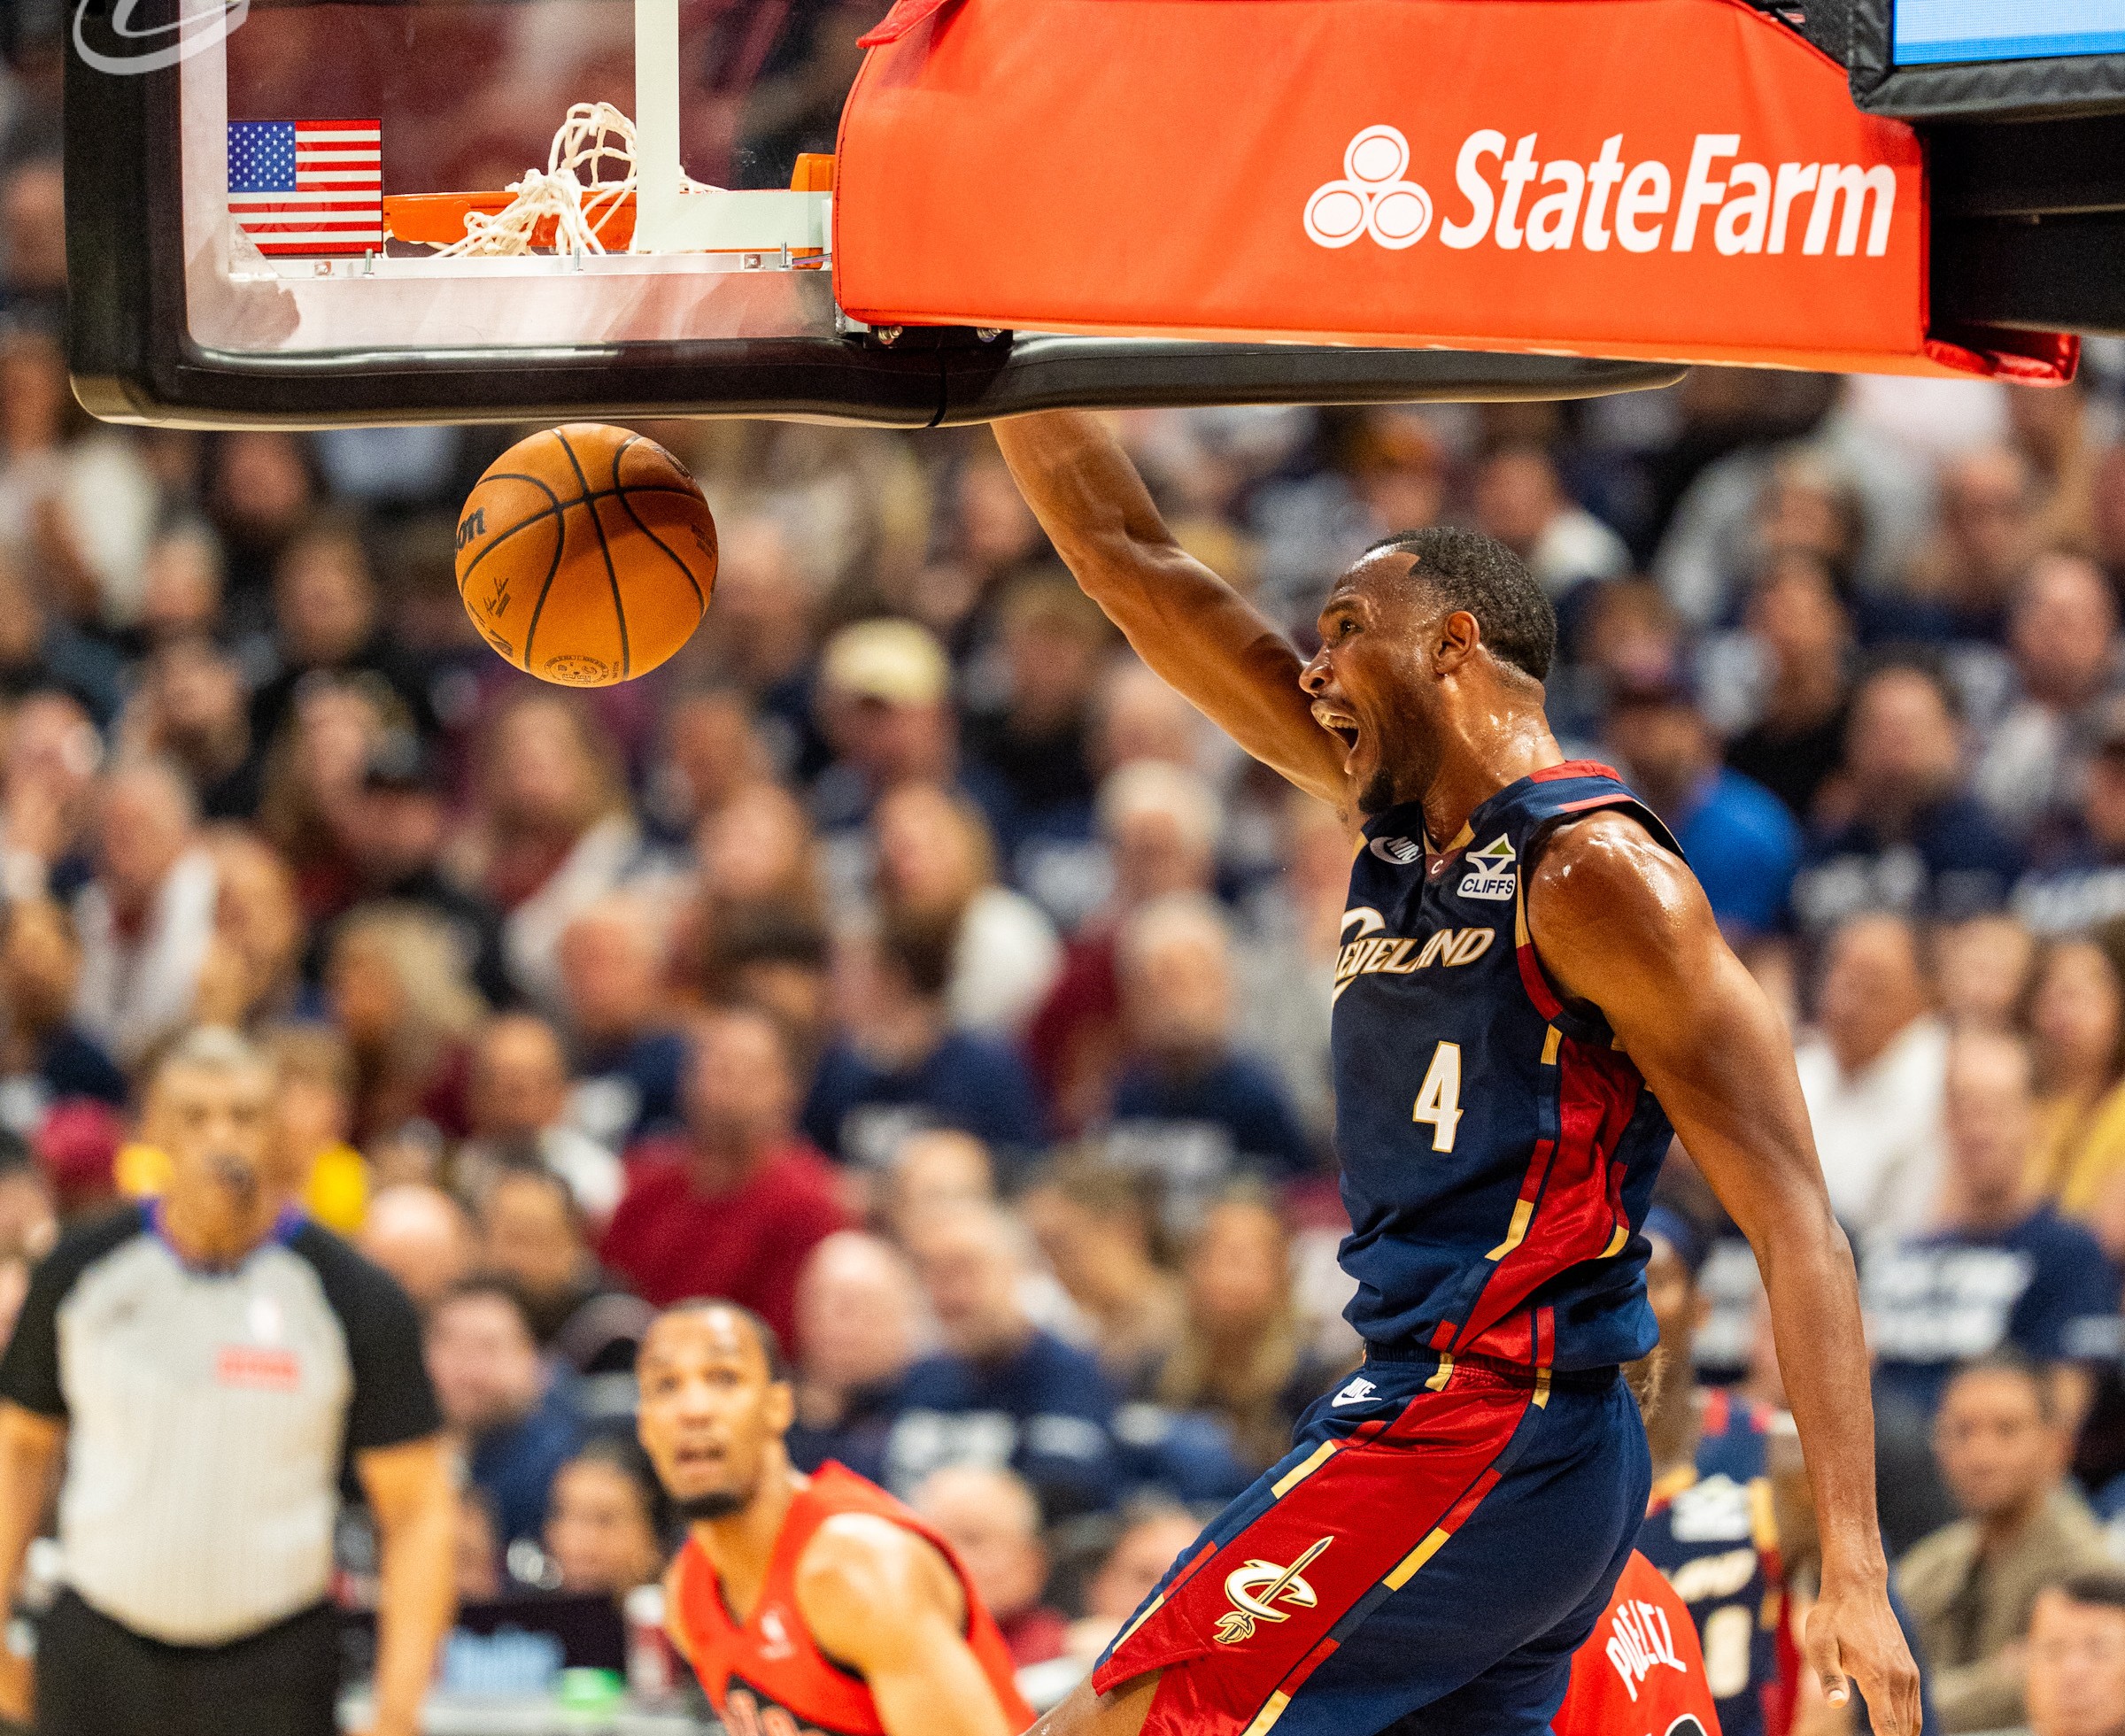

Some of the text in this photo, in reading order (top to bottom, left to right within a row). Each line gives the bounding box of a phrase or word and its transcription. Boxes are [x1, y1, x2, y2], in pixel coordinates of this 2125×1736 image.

[1439, 128, 1897, 257] State Farm
[1462, 878, 1515, 895] CLIFFS
[1412, 1040, 1464, 1153] 4
